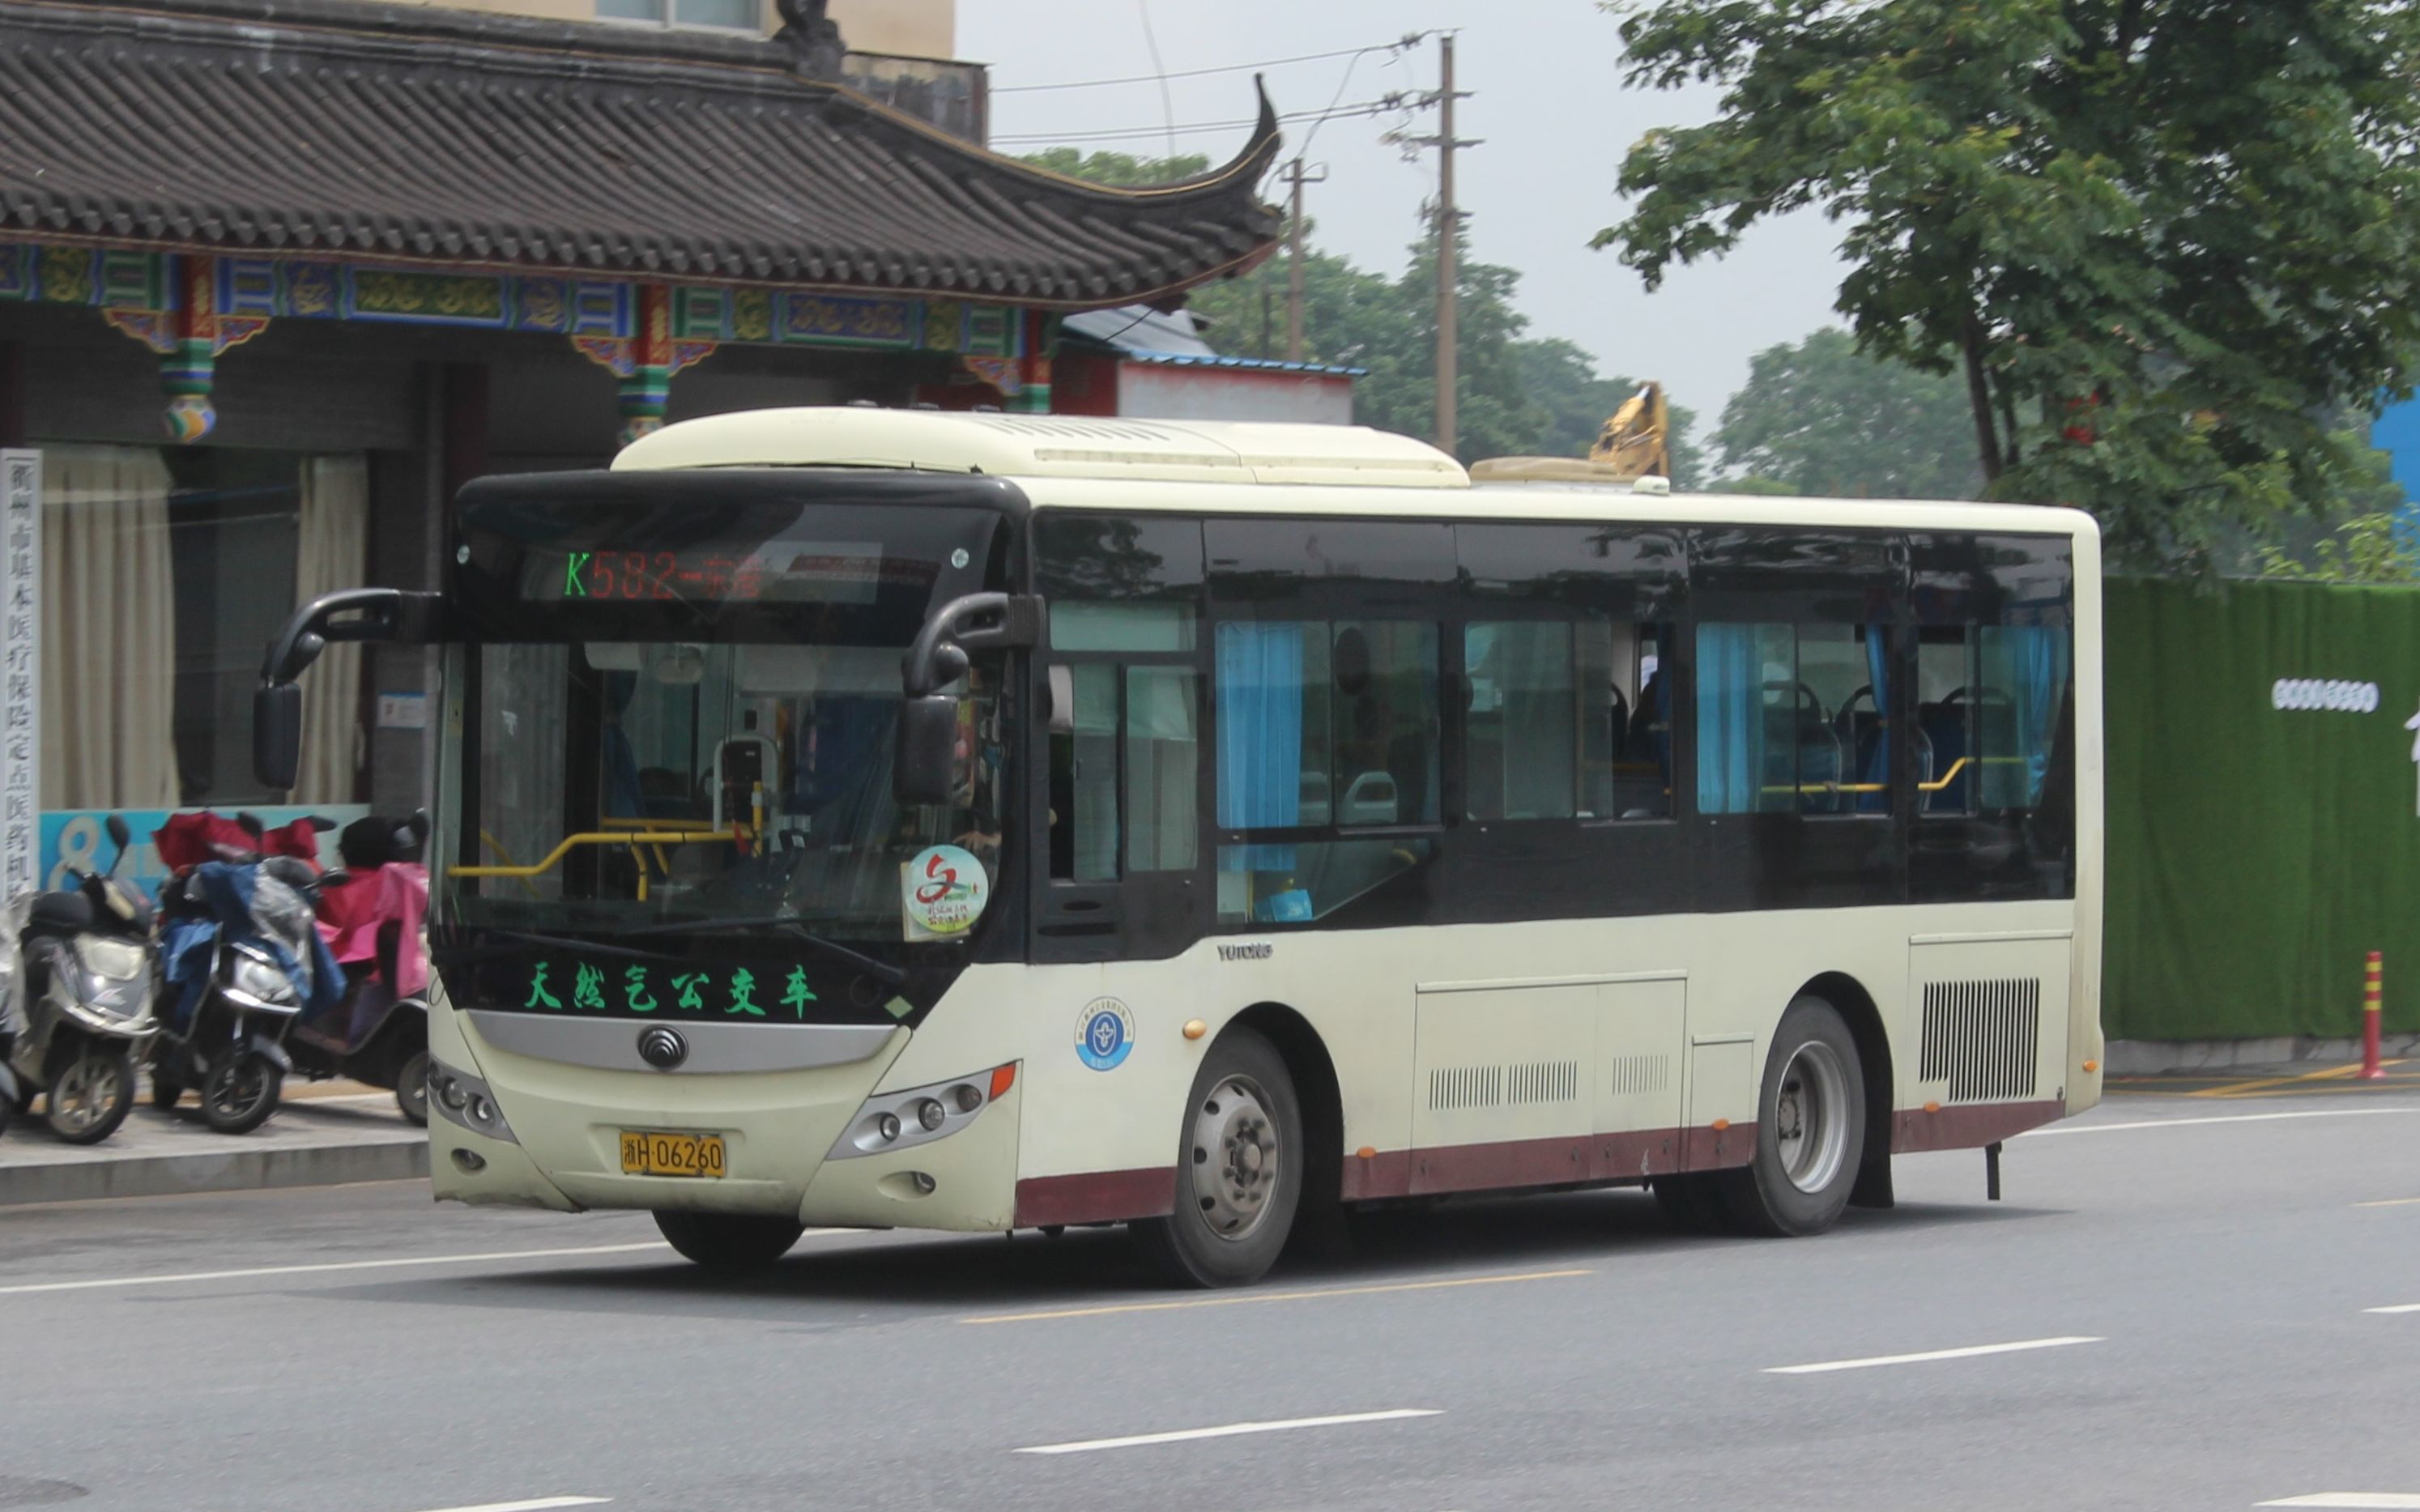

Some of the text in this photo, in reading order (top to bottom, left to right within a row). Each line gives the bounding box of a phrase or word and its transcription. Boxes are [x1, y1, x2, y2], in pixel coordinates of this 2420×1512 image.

[1217, 943, 1273, 962] YUTONG
[525, 961, 817, 1020] 天然气公交车
